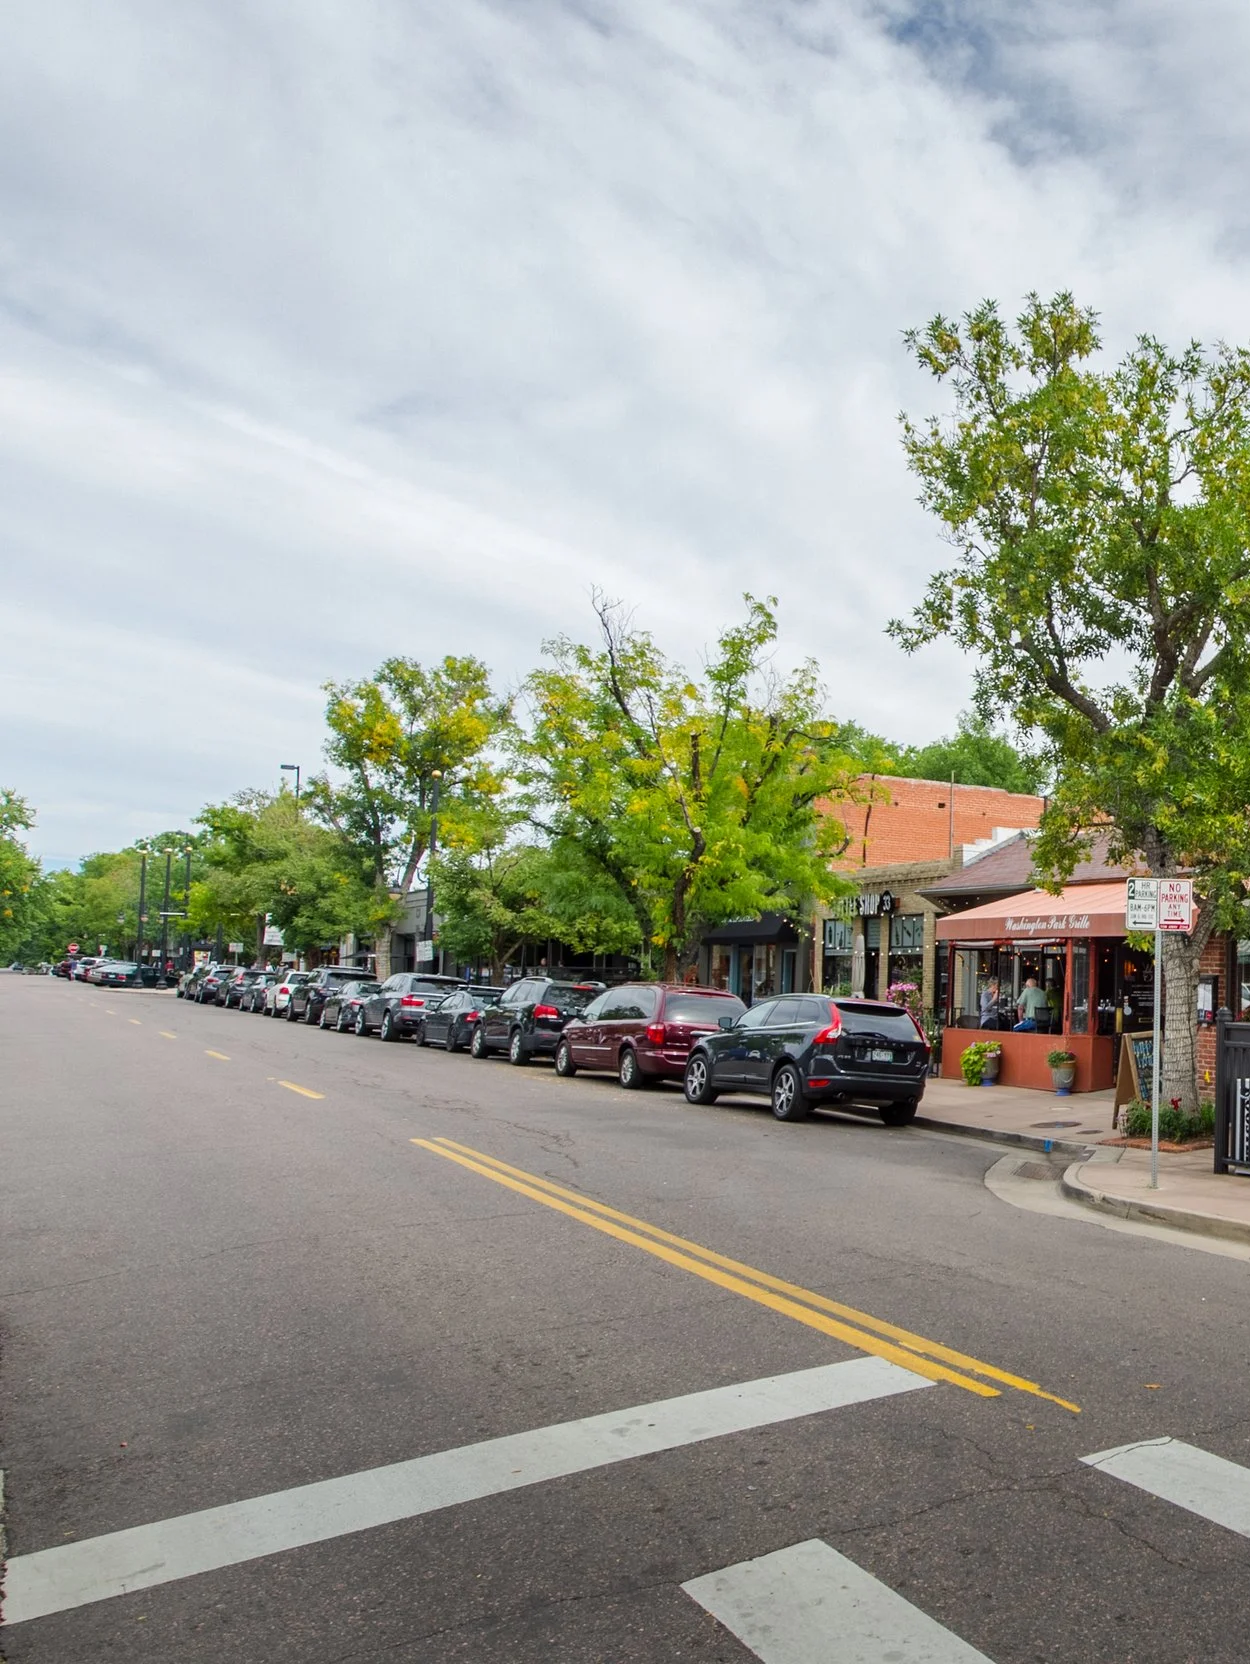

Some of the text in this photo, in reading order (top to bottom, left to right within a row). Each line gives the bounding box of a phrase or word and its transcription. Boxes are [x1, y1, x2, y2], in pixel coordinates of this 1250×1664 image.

[1128, 883, 1135, 897] 2
[1169, 883, 1181, 892] NO
[1135, 890, 1157, 898] PARKING
[1161, 893, 1189, 903] PARKING
[859, 893, 880, 916] SHOP
[882, 894, 891, 911] 33
[1167, 910, 1182, 918] TIME
[1004, 914, 1091, 936] Washington Park Grille
